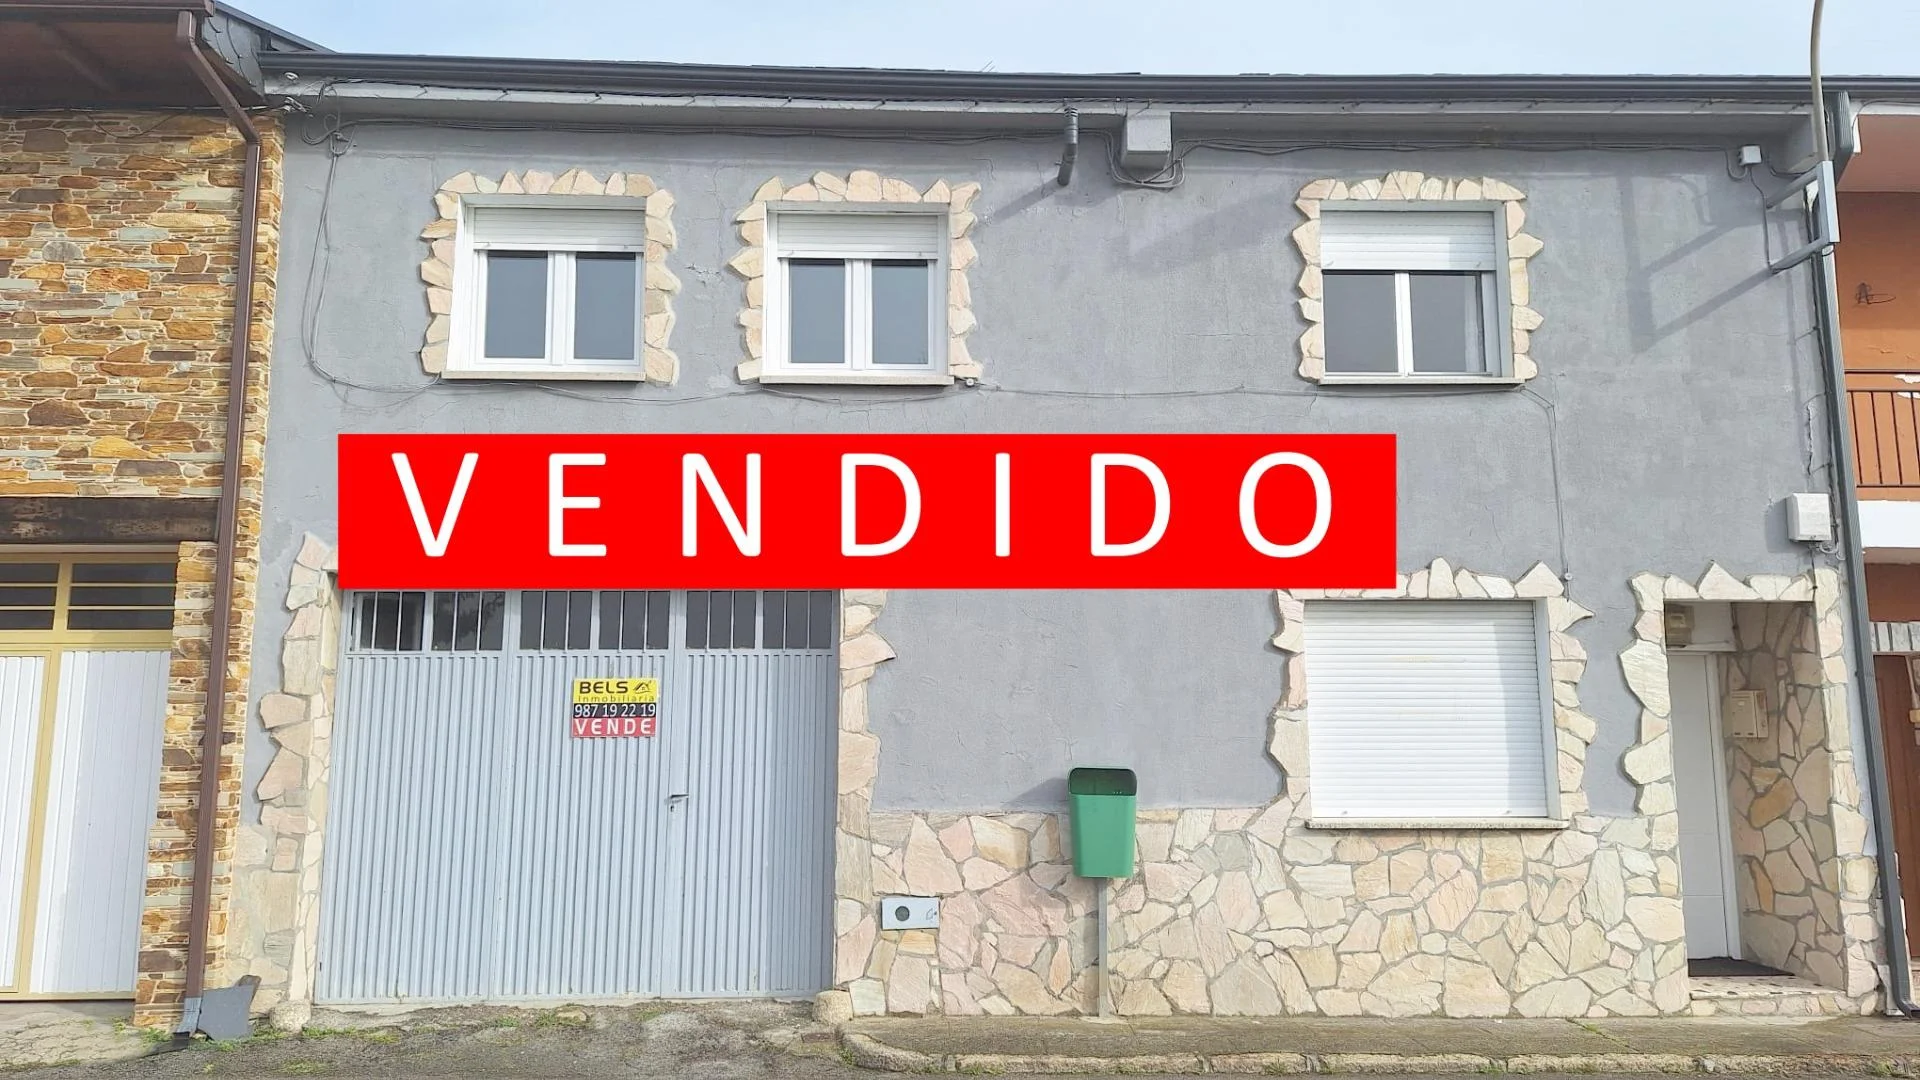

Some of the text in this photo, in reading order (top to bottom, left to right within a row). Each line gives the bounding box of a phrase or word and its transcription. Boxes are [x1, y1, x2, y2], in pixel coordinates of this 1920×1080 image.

[579, 681, 628, 694] BELS
[574, 703, 656, 717] 987 19 22 19
[575, 718, 652, 735] VENDE
